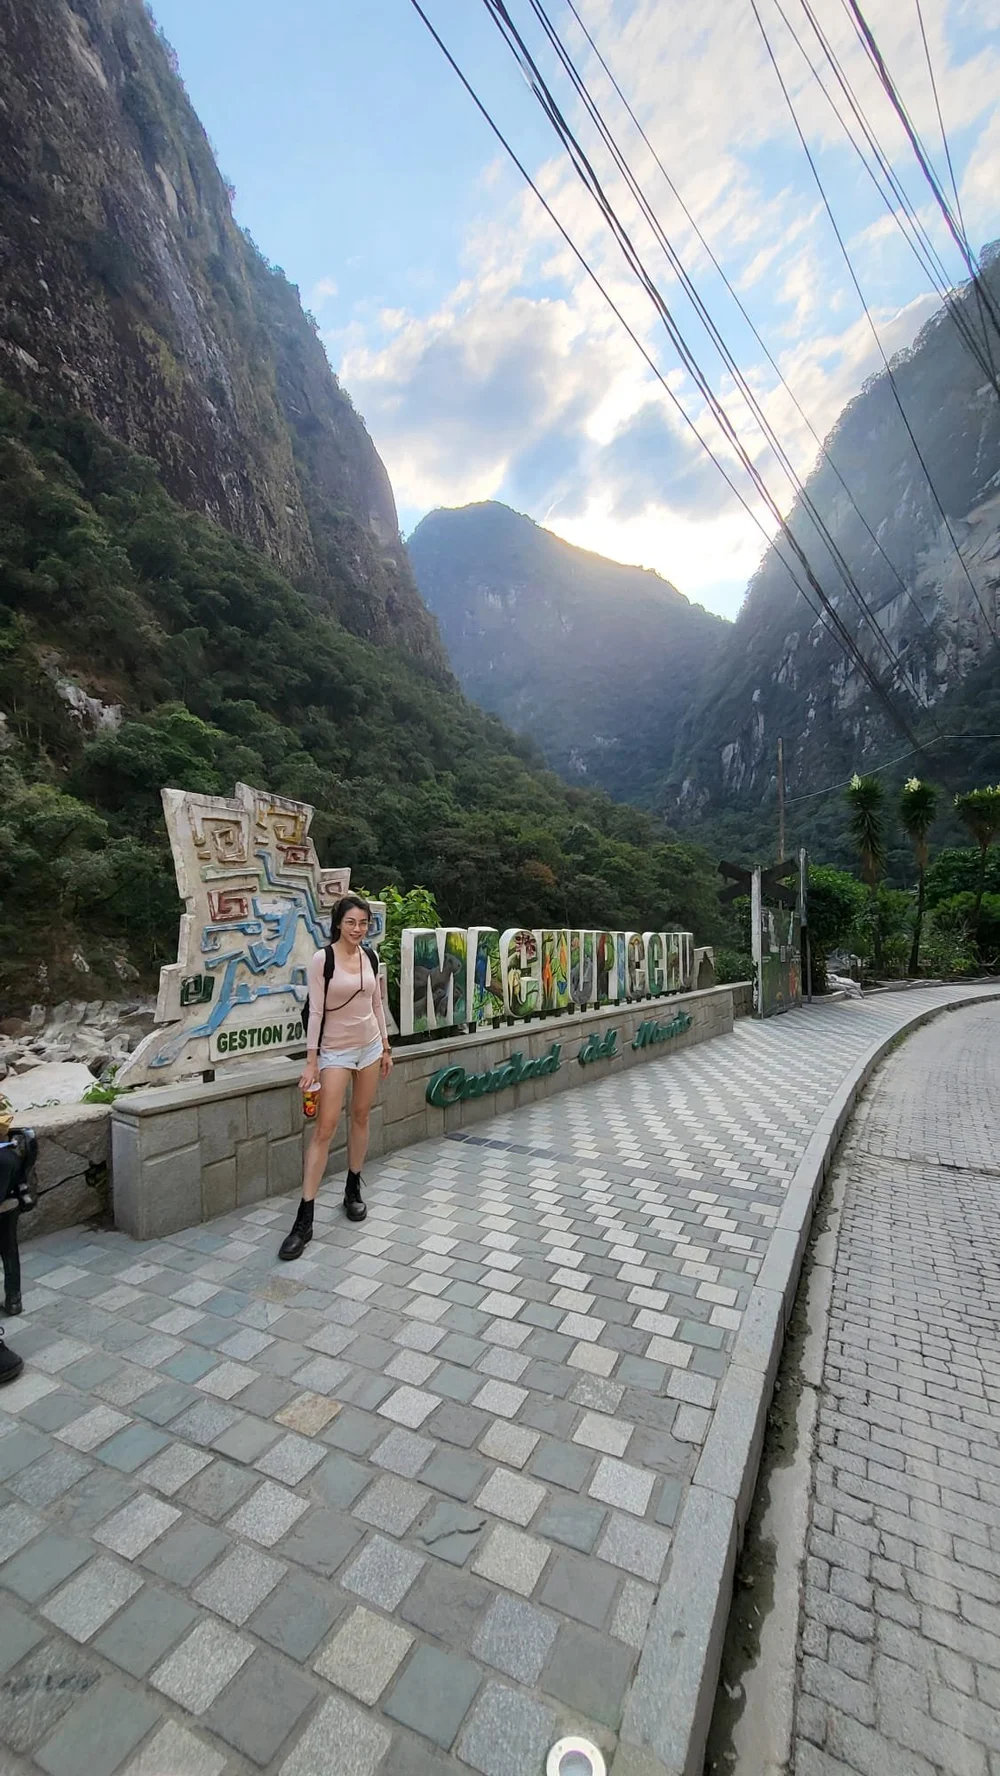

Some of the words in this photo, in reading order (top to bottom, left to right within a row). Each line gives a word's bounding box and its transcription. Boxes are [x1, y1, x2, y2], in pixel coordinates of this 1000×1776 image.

[400, 926, 694, 1036] MACHUPICCHU
[216, 1024, 283, 1053] GESTION
[426, 1043, 562, 1108] Ciudad
[577, 1028, 618, 1068] del
